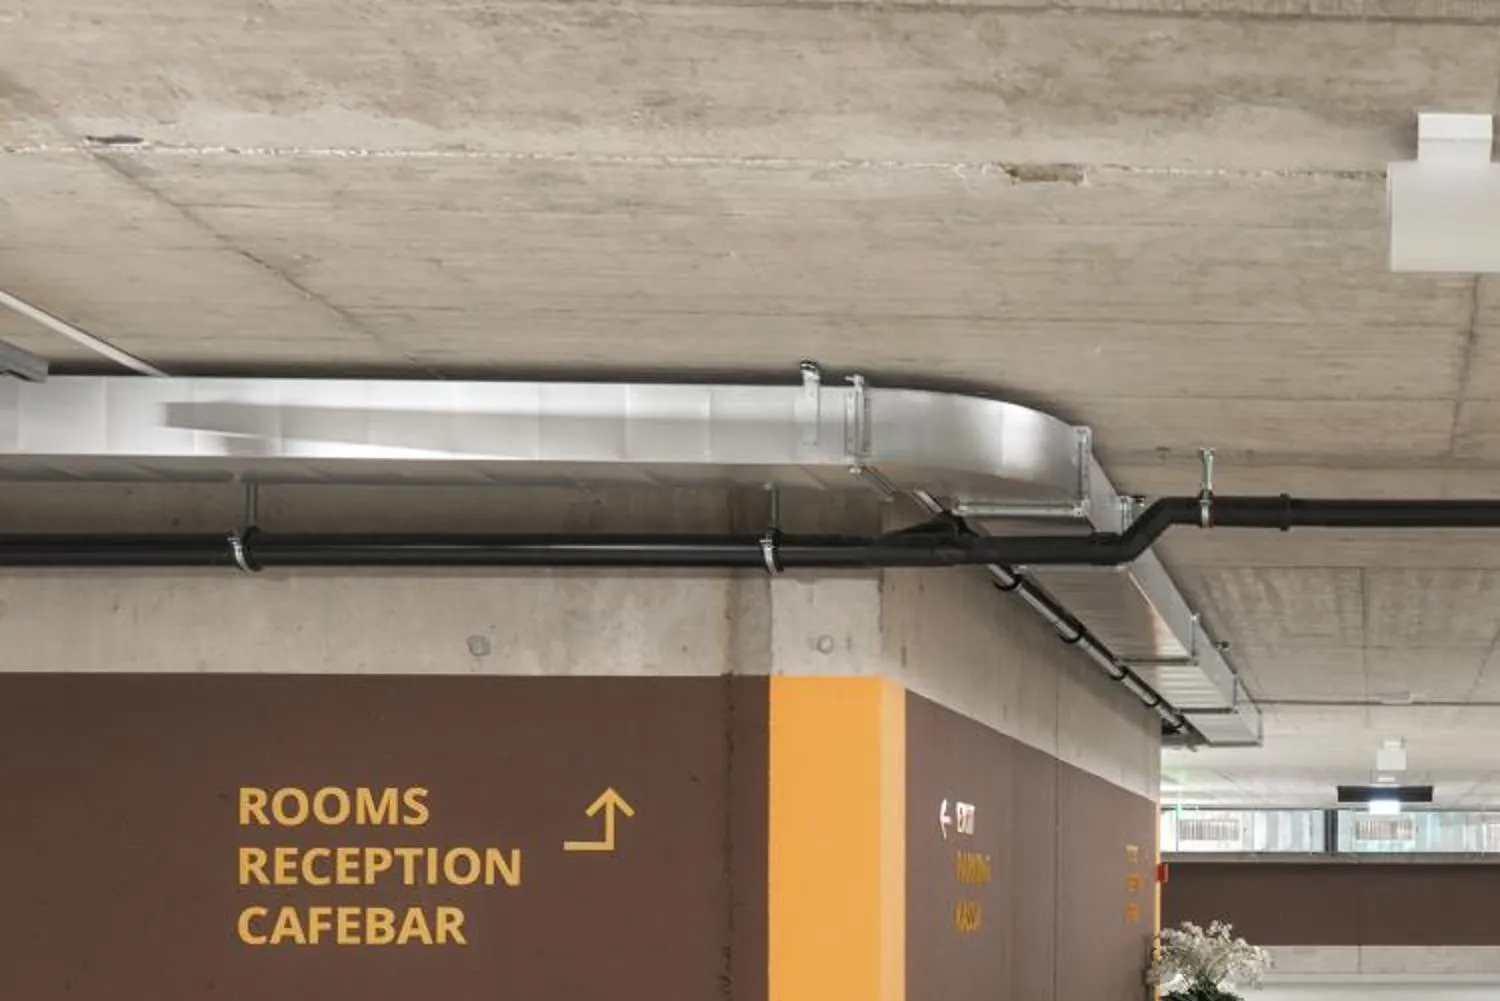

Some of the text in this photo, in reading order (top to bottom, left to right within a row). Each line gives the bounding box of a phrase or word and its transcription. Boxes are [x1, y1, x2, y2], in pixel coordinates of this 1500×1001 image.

[238, 787, 430, 825] ROOMS
[238, 847, 522, 886] RECEPTION
[237, 906, 468, 945] CAFEBAR
